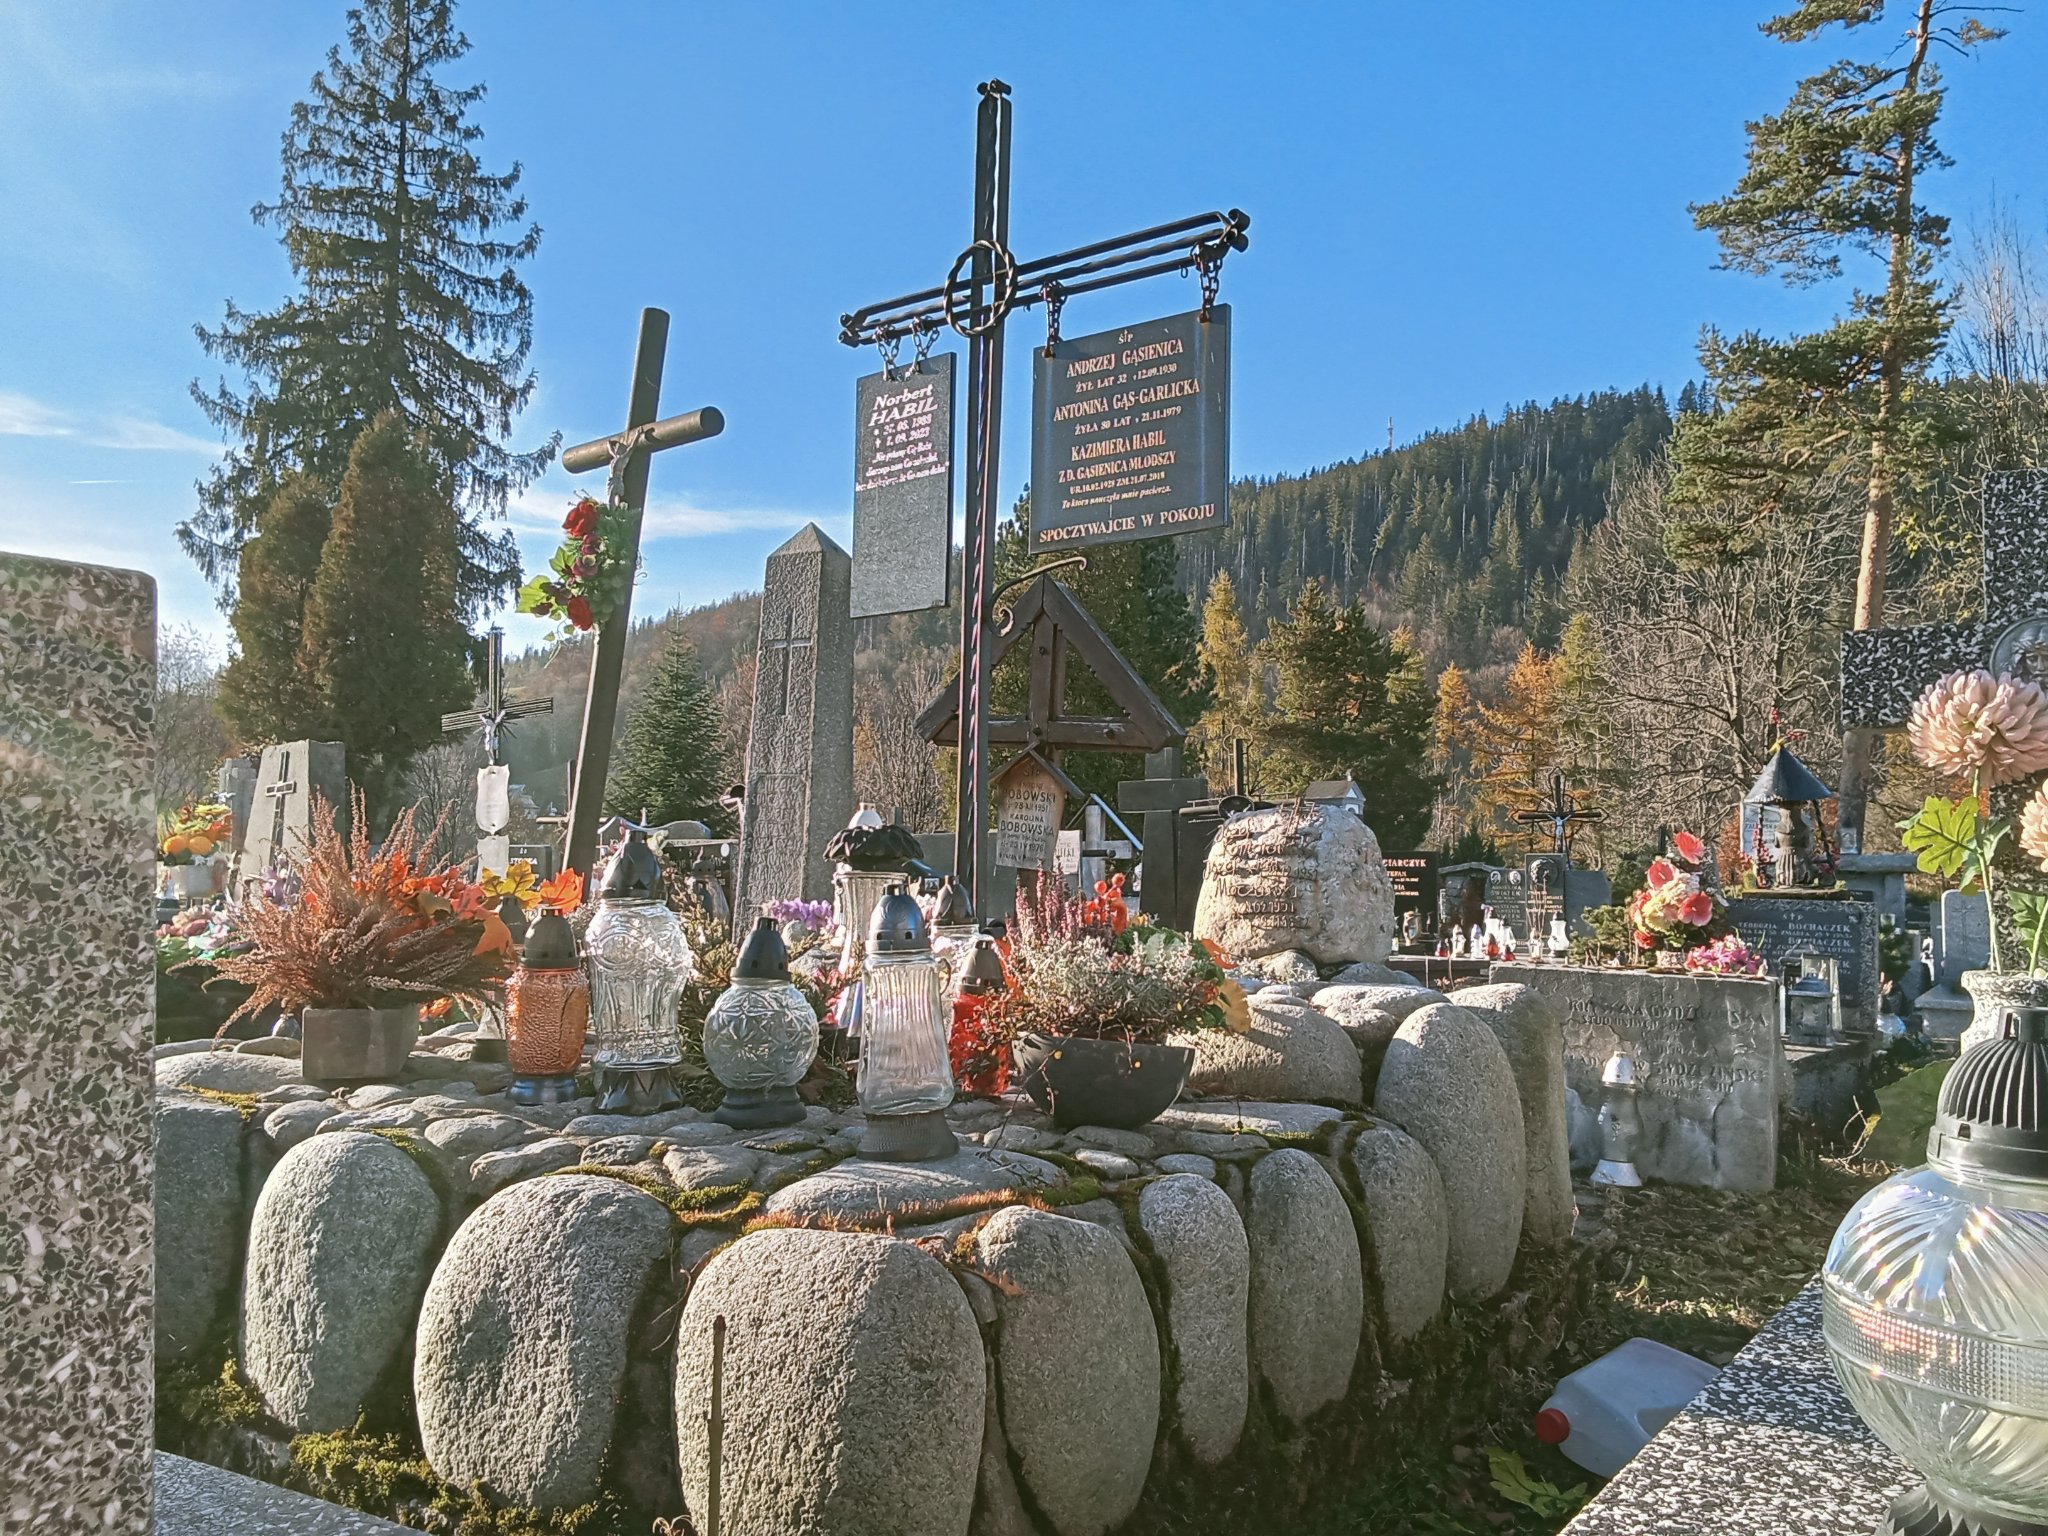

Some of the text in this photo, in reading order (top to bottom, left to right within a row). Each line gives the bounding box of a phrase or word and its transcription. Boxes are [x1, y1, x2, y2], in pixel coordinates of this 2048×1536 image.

[1066, 338, 1184, 378] ANDRZEJ GĄSIENICA
[1097, 376, 1114, 388] LAT
[873, 384, 933, 410] Norbert
[1053, 378, 1200, 422] ANTONINA GĄS-GARLICKA
[868, 397, 938, 426] HABIL
[1114, 416, 1132, 427] LAT
[1071, 430, 1166, 461] KAZIMIERA HABIL
[1039, 504, 1215, 543] SPOCZYWAJCIE W POKOJU
[1000, 820, 1054, 837] BOBOWSKA
[1382, 859, 1426, 867] CIARCZYK
[1789, 922, 1850, 932] BOCHACZEK
